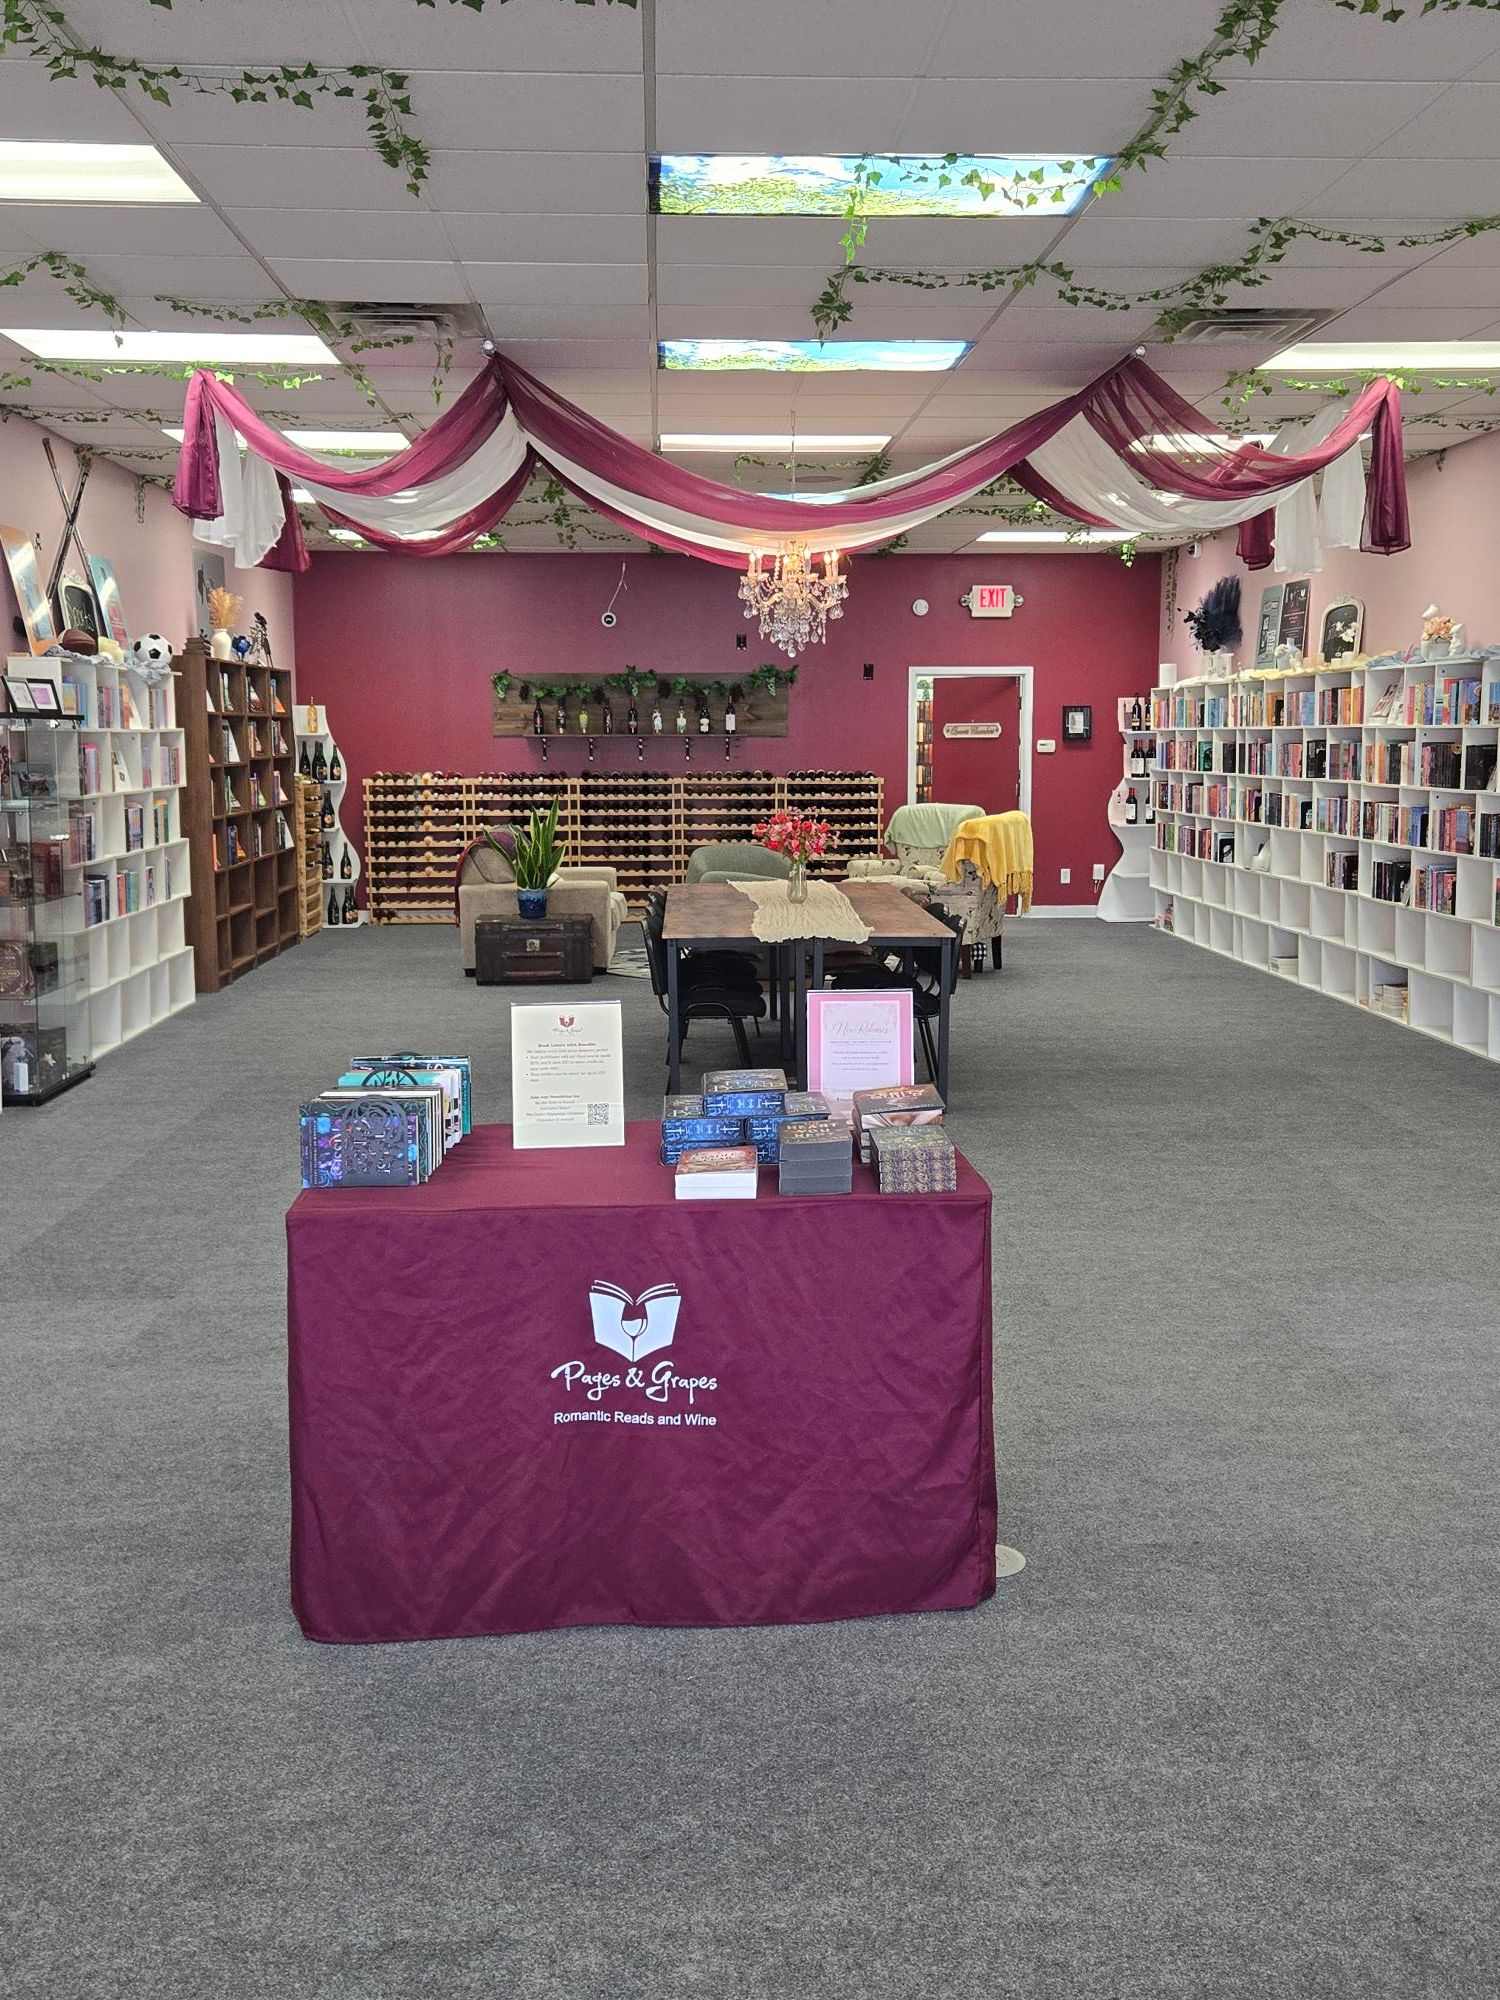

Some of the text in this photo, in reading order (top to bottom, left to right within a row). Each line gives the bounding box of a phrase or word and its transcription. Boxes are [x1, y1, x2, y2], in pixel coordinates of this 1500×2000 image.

[980, 588, 1007, 608] EXIT
[551, 1360, 718, 1405] Pages & Grapes
[554, 1410, 717, 1426] Romantic Reads and Wine
